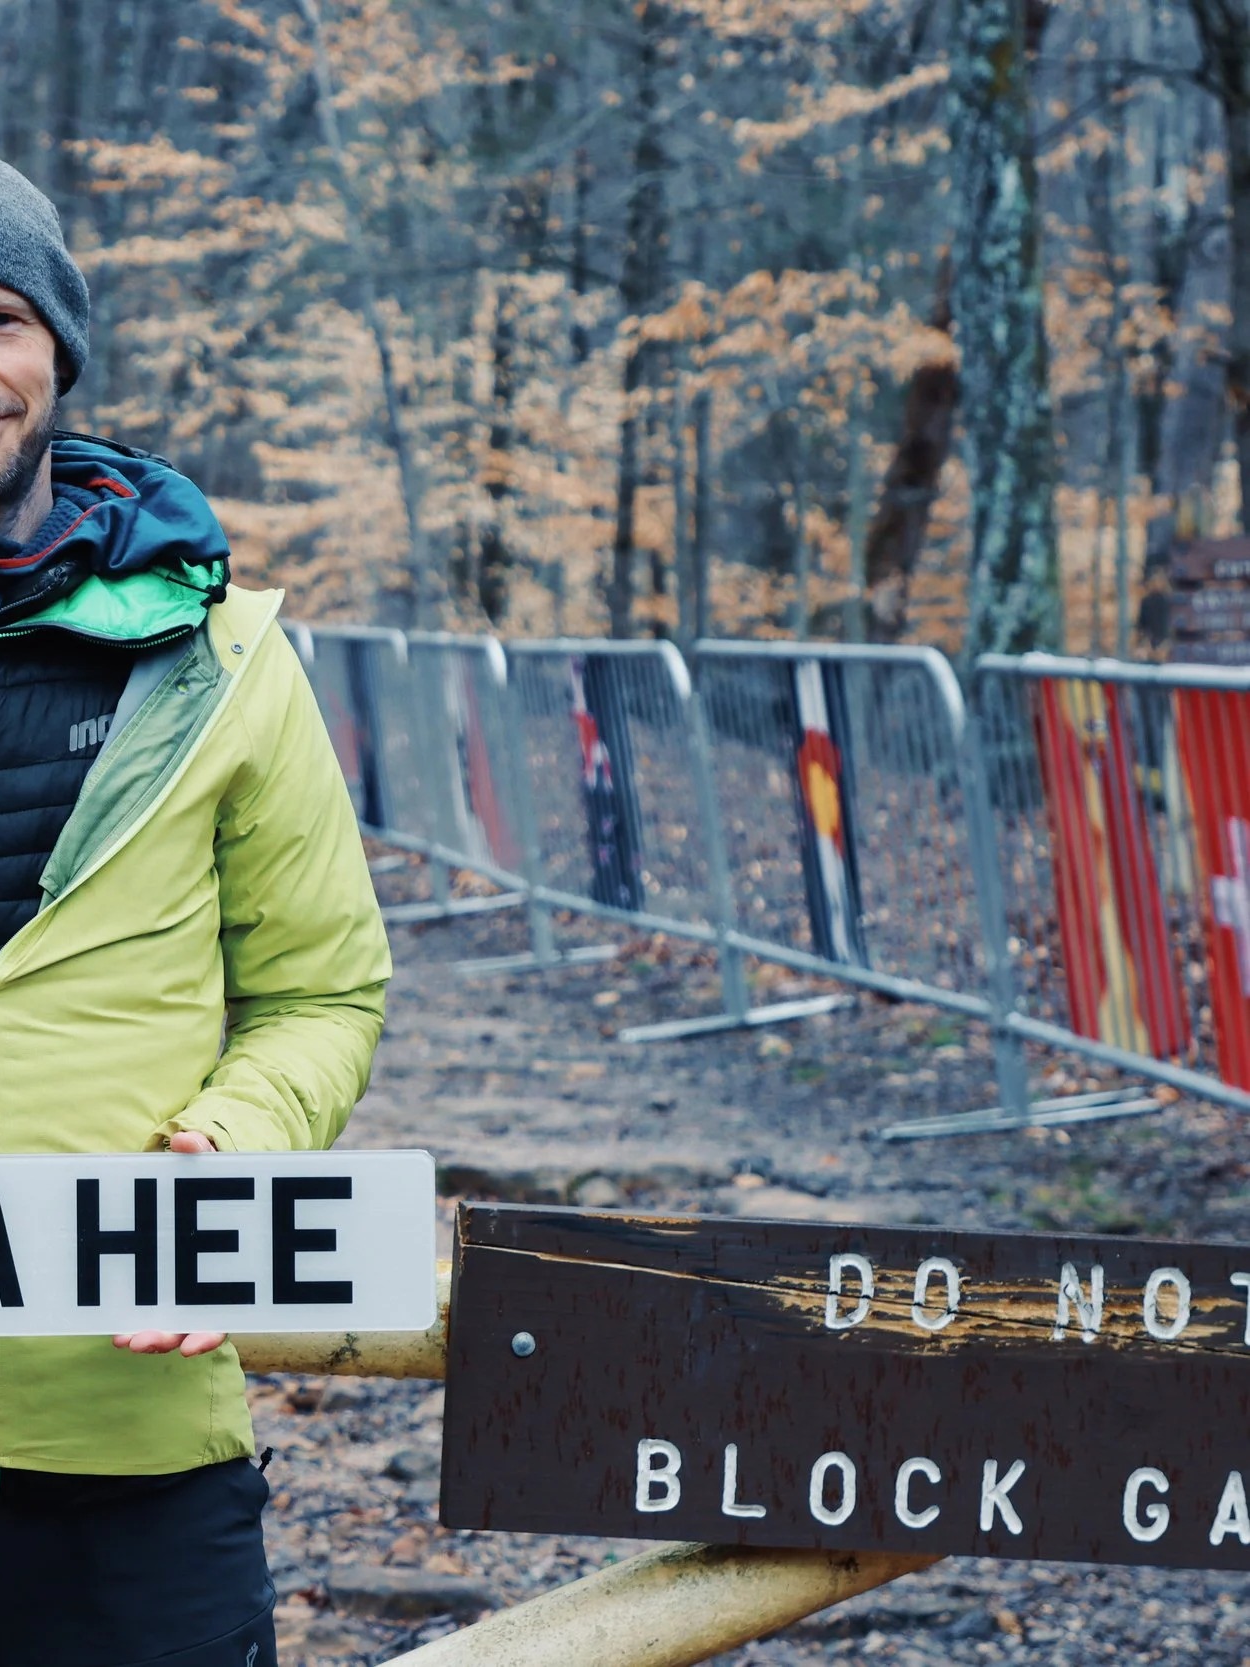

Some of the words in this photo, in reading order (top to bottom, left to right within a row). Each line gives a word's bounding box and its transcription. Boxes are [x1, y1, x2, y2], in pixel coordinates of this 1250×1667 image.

[77, 1177, 353, 1307] HEE
[824, 1253, 962, 1331] DO
[635, 1438, 1026, 1535] BLOCK
[1123, 1467, 1250, 1546] GA
